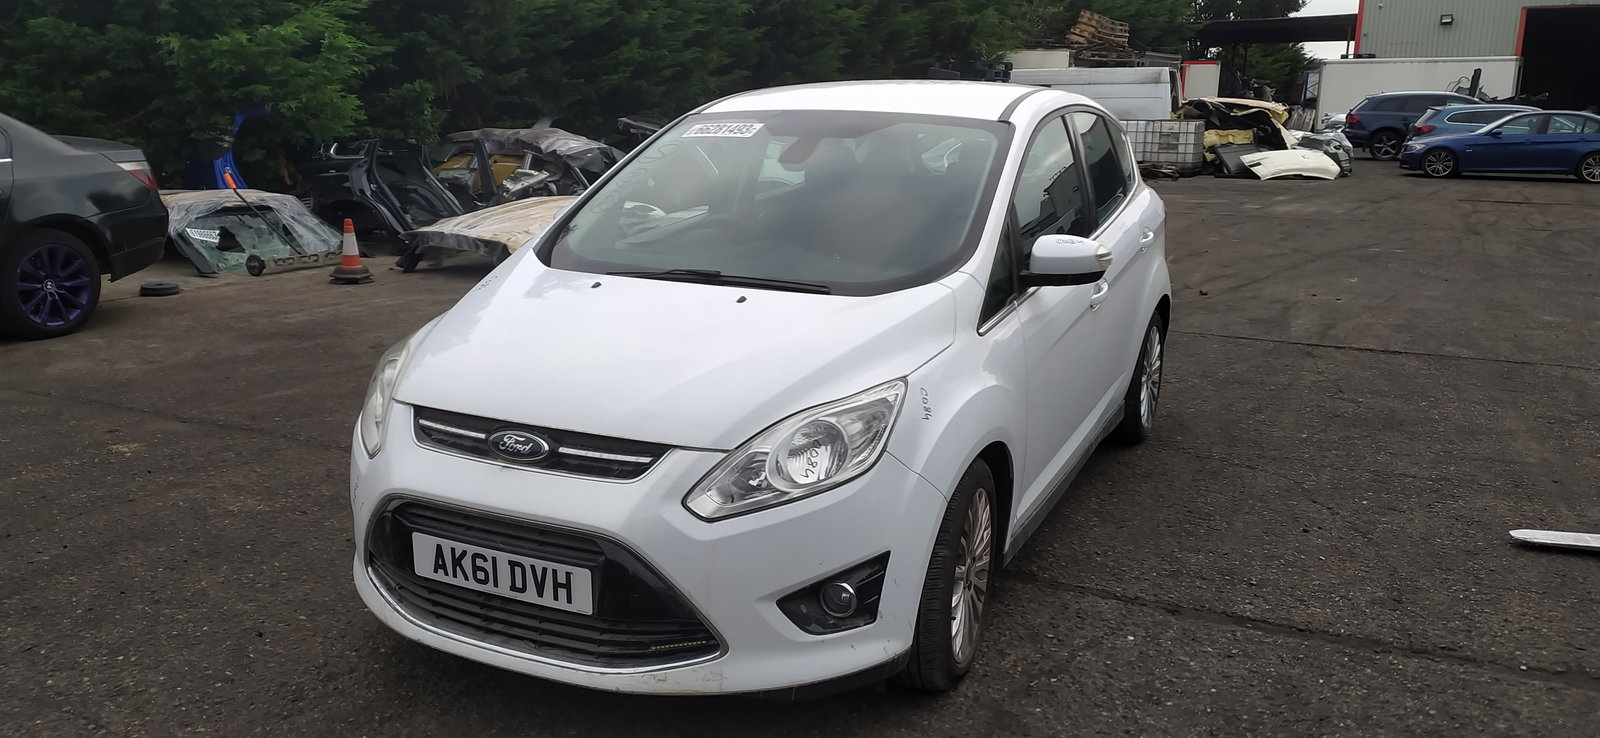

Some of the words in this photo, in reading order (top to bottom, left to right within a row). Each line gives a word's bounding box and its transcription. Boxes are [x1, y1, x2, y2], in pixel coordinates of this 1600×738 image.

[499, 434, 533, 454] Ford
[433, 543, 499, 588] AK61
[508, 559, 574, 605] DVH
